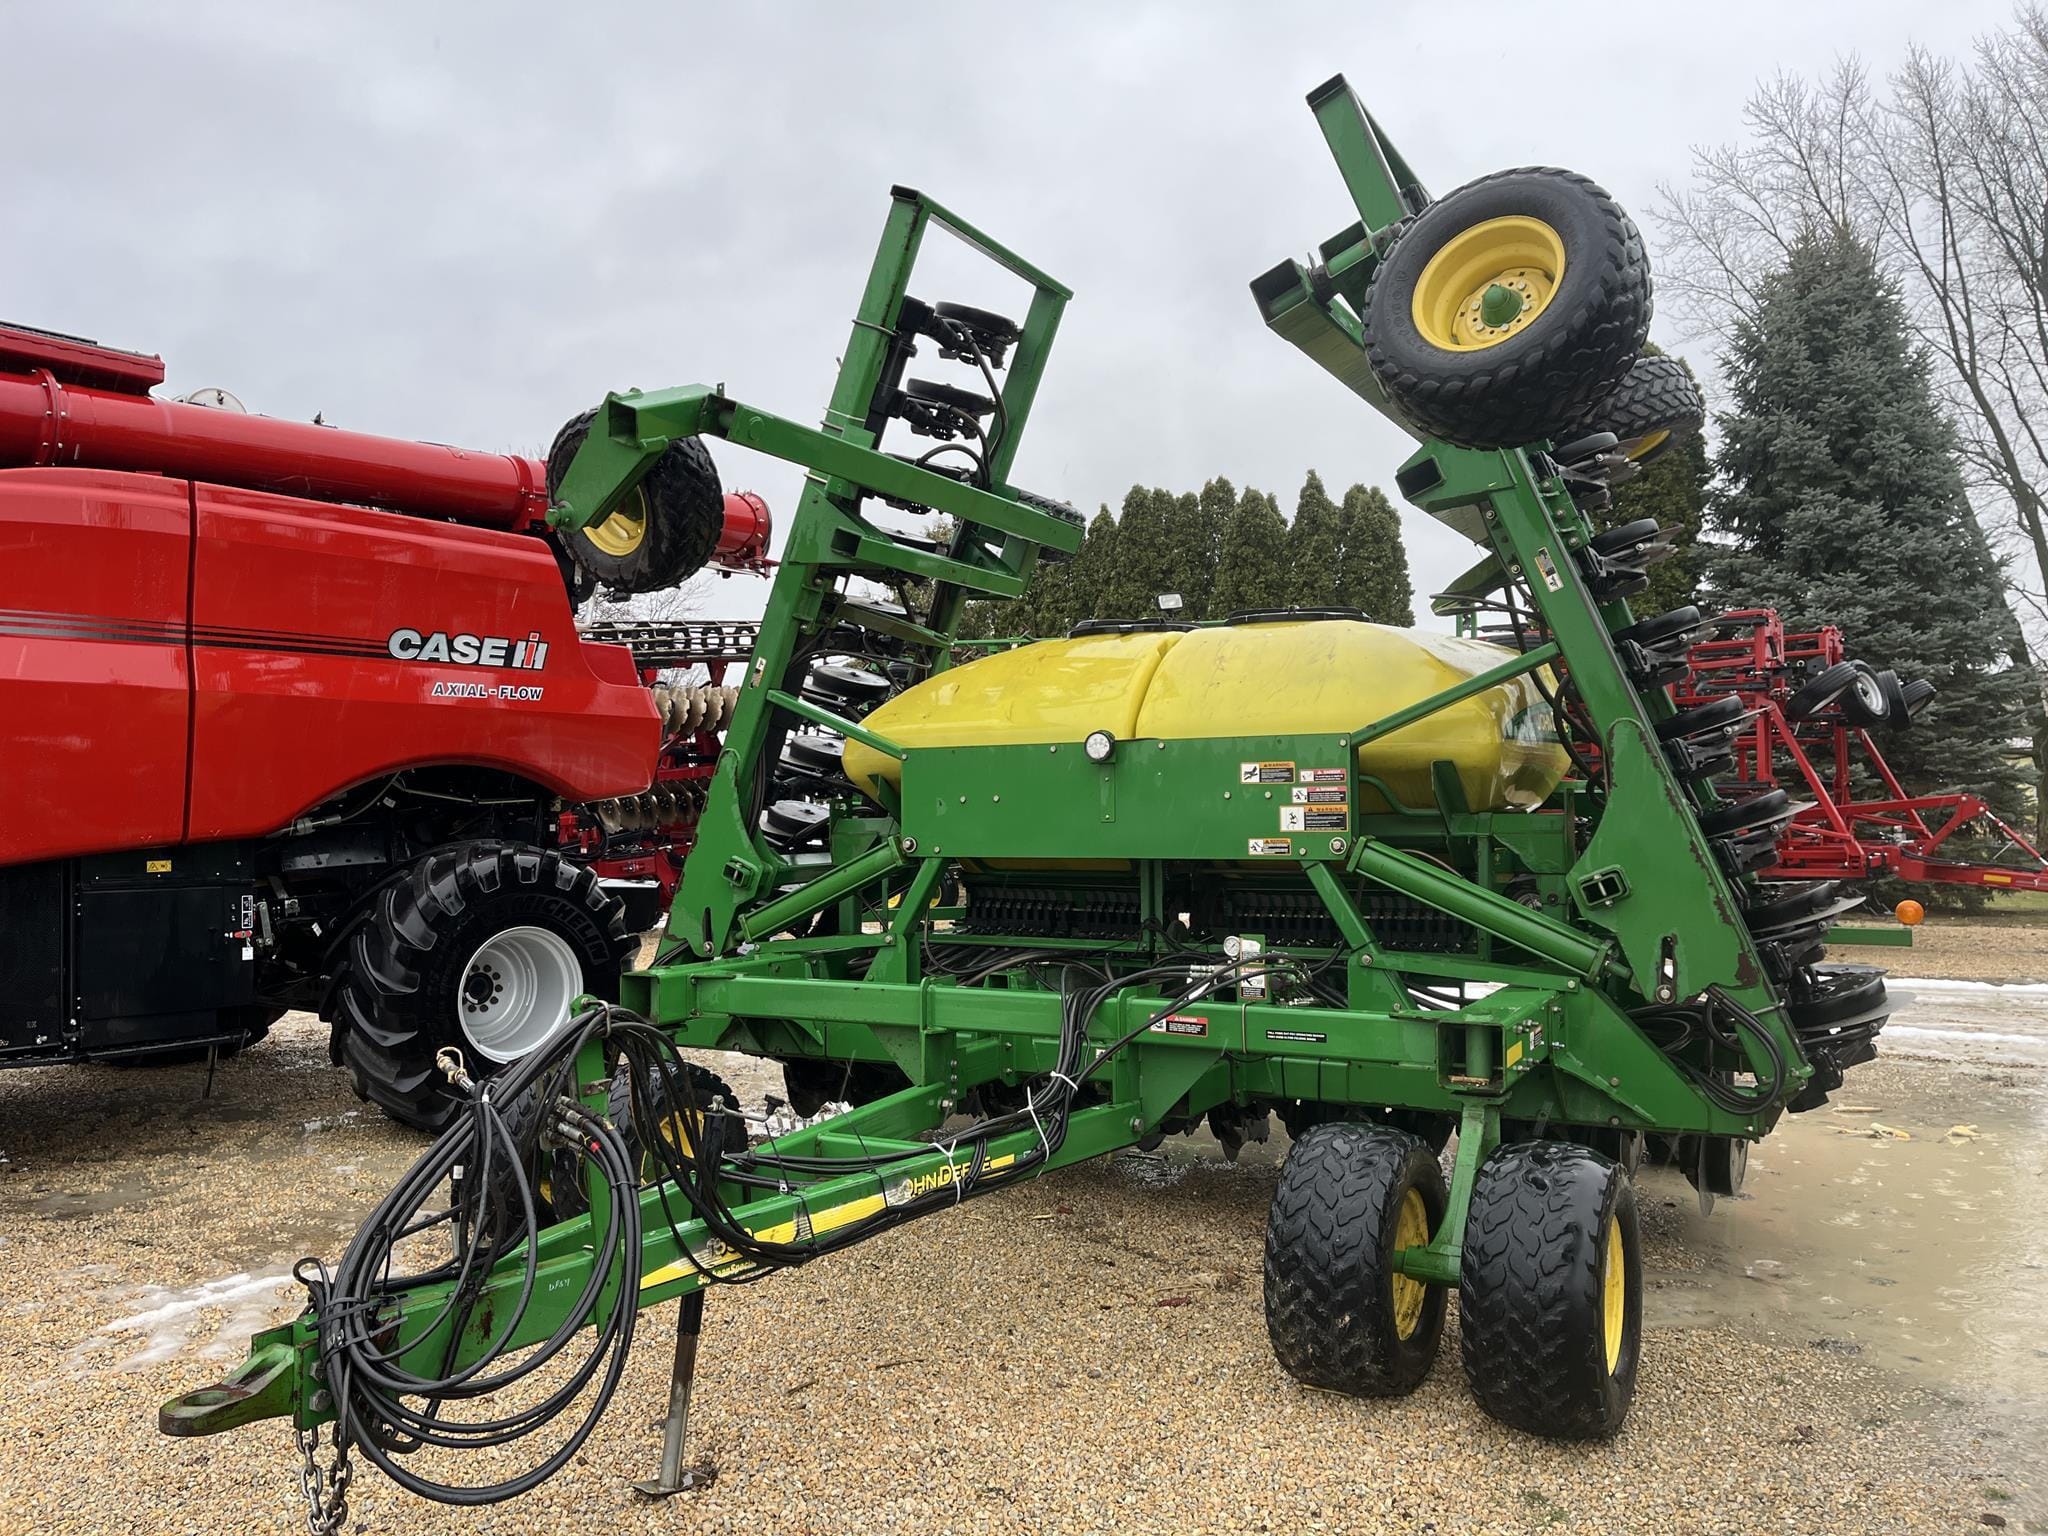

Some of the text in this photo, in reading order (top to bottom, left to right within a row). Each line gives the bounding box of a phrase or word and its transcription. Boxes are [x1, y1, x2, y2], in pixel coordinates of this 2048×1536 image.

[388, 629, 507, 666] CASE
[431, 682, 543, 701] AXIAL-FLOW
[512, 895, 609, 964] MICHELIN
